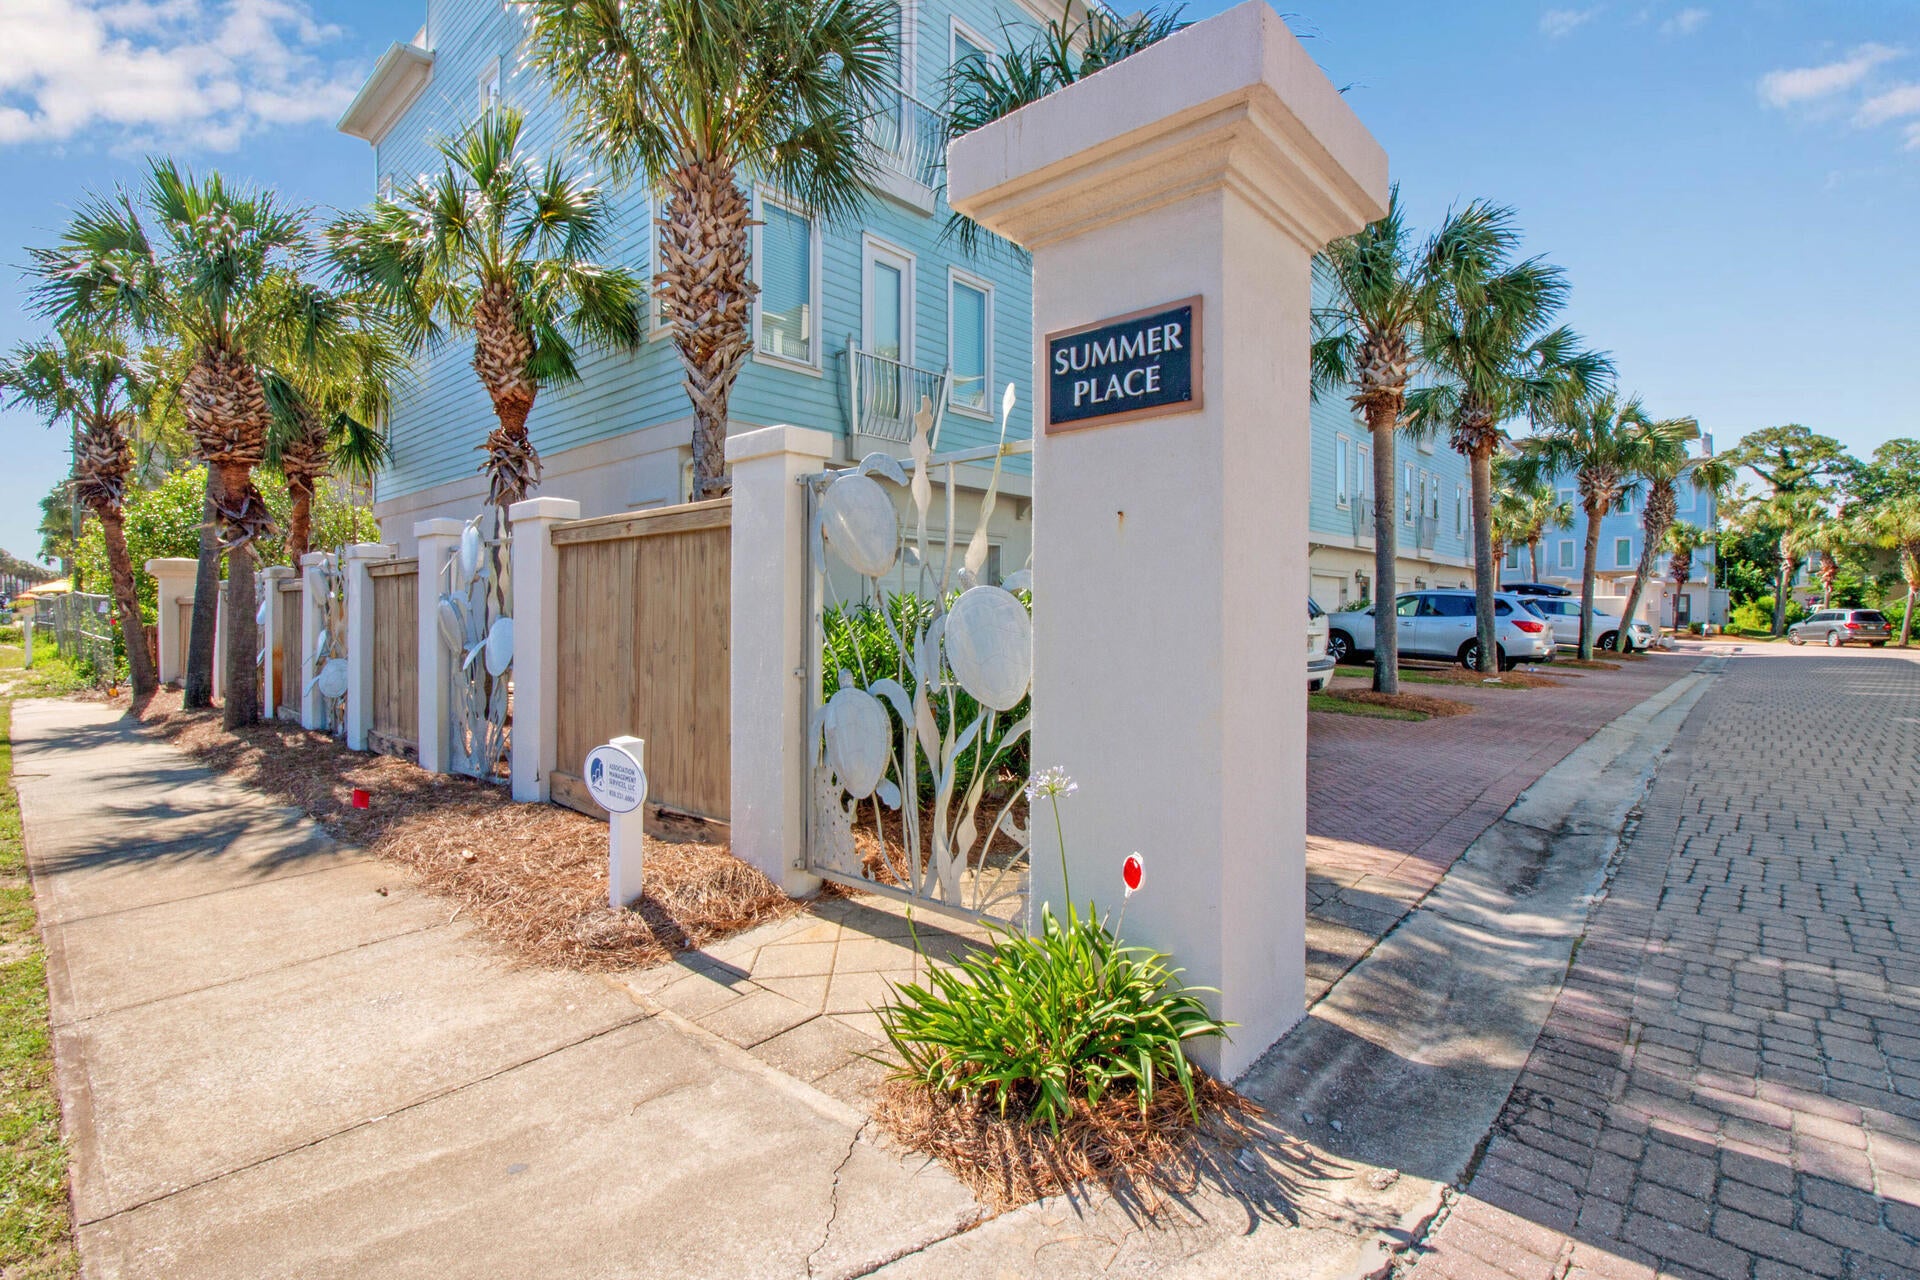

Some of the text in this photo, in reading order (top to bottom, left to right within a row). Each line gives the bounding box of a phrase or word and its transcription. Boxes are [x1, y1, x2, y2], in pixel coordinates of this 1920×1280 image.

[1054, 322, 1183, 375] SUMMER
[1074, 365, 1161, 407] PLACE
[609, 764, 635, 776] ASSOCIATION
[609, 771, 637, 784] MANAGEMENT
